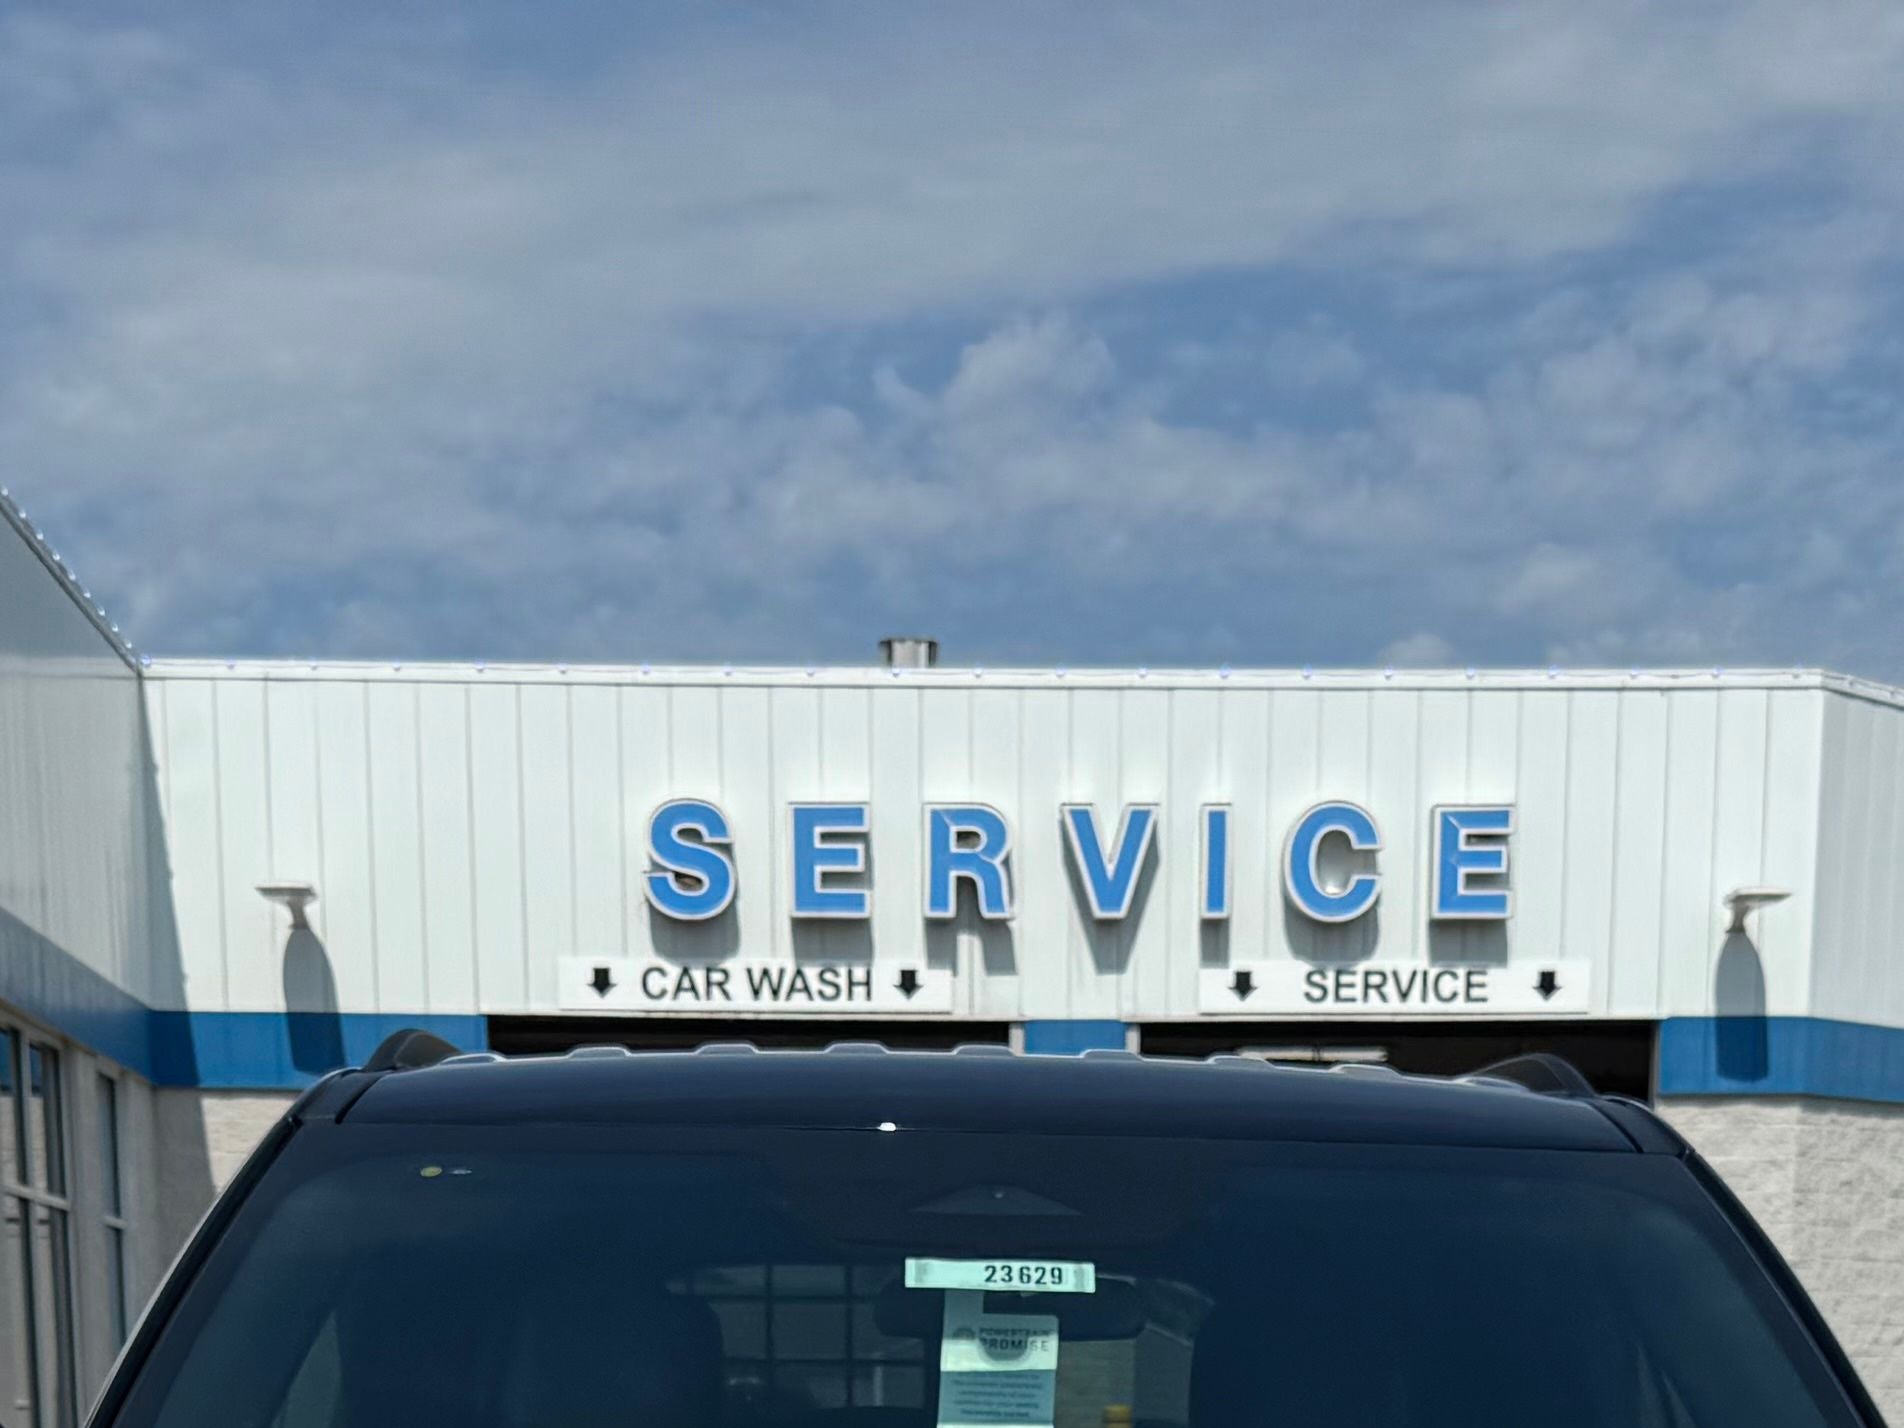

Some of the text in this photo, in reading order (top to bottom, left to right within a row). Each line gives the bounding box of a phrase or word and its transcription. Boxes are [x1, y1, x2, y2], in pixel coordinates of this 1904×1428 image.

[645, 798, 1514, 923] SERVICE
[641, 965, 872, 1001] CAR WASH
[1304, 967, 1488, 1004] SERVICE
[984, 1264, 1063, 1286] 23629
